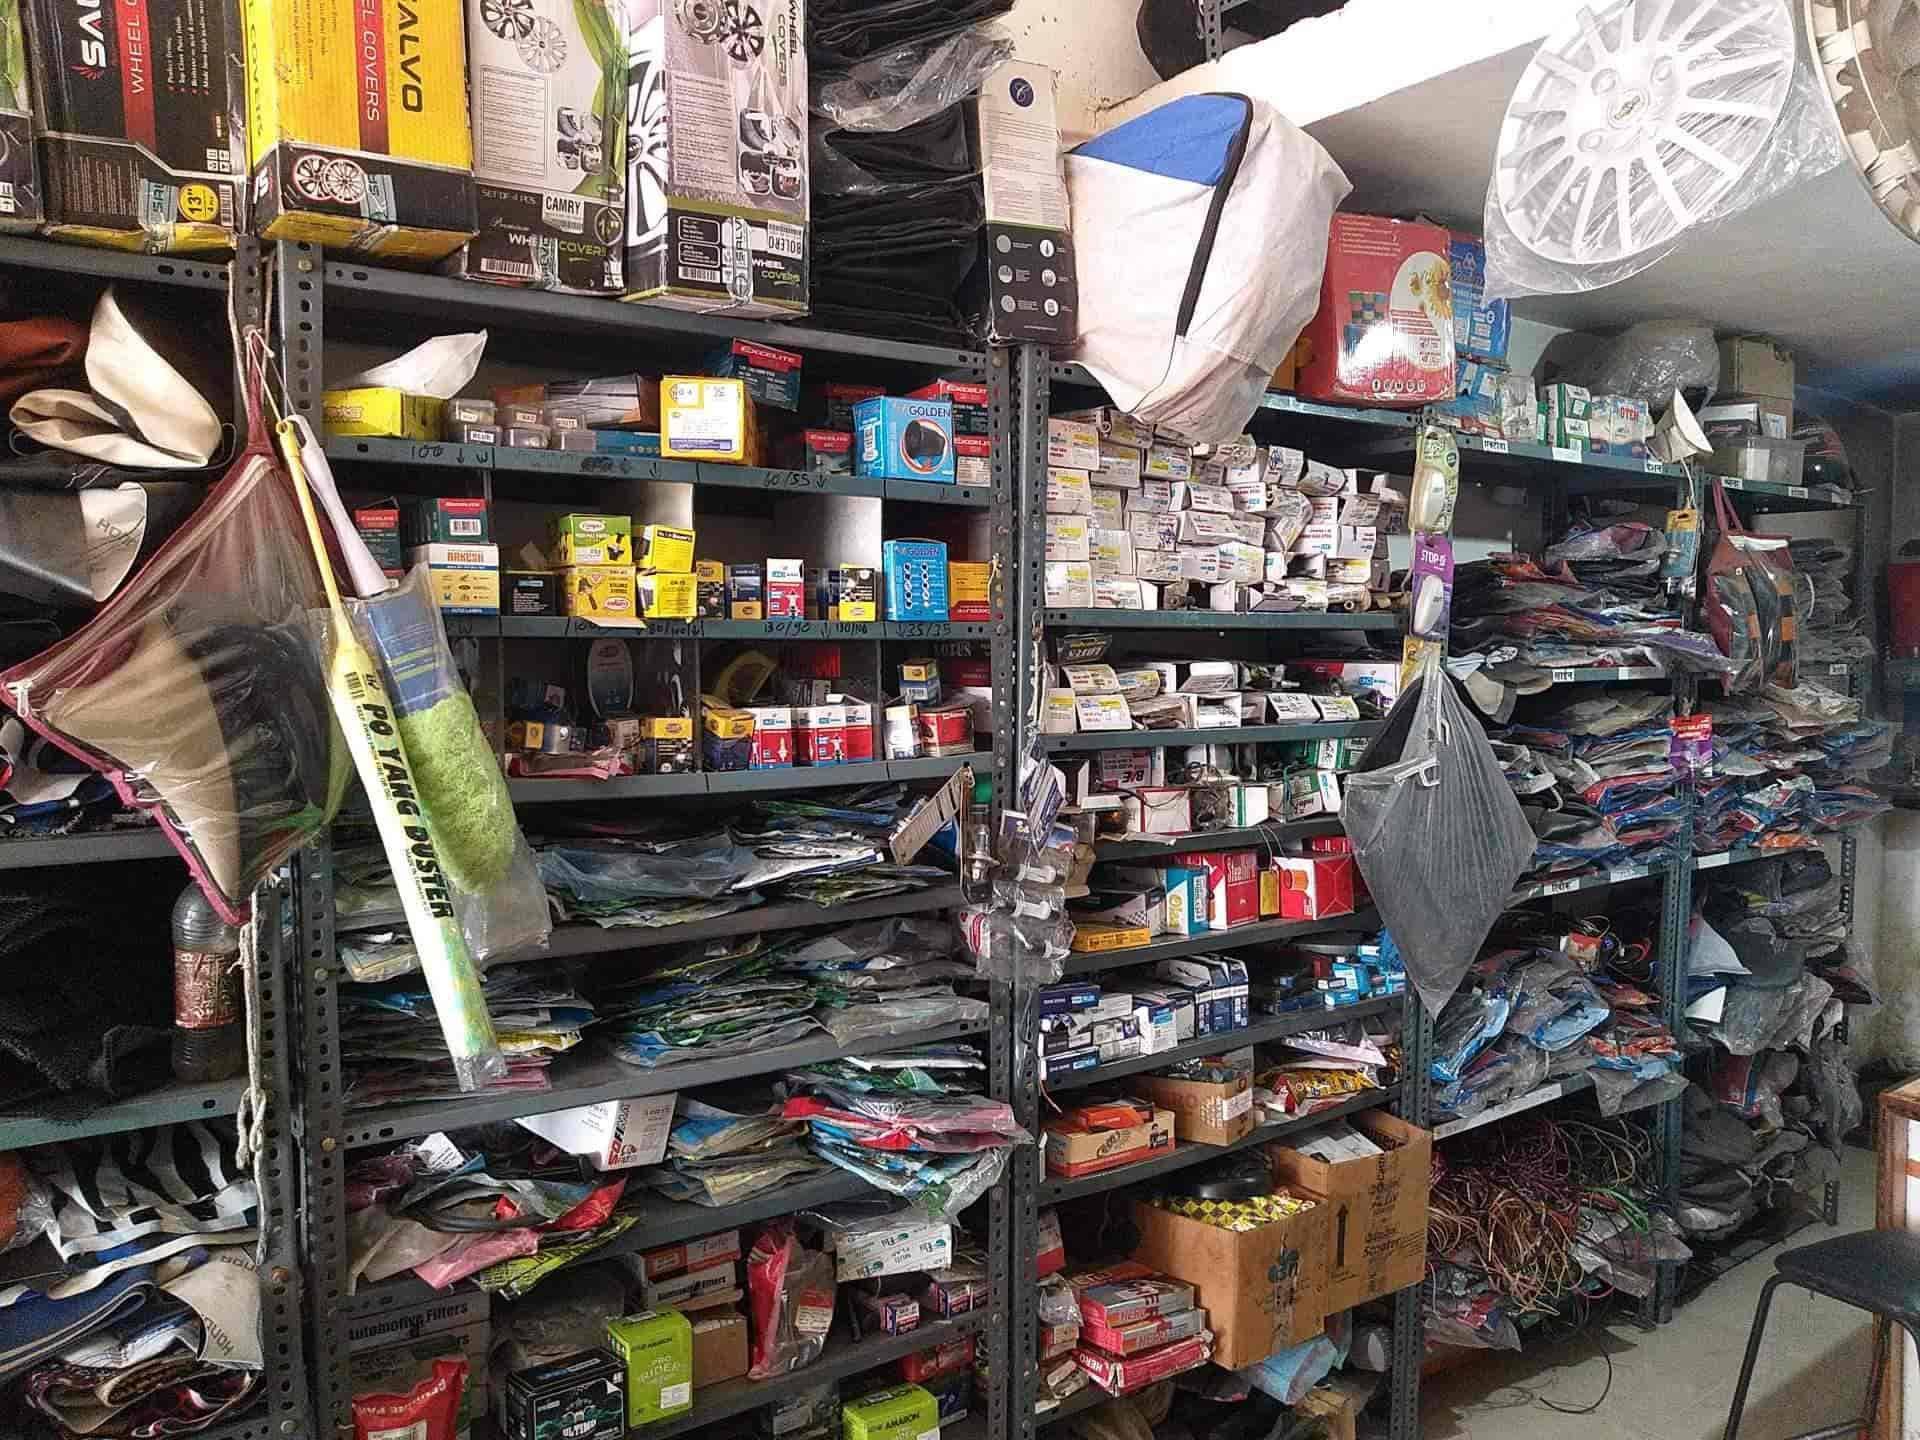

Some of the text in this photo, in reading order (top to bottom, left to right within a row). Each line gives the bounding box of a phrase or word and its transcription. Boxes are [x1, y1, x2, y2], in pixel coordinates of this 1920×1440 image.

[130, 13, 148, 94] WHEEL
[399, 0, 423, 114] ALVO
[778, 14, 787, 87] COVERS
[789, 0, 798, 59] WHEEL
[360, 31, 380, 122] COVERS
[545, 195, 582, 216] CAMRY
[767, 234, 802, 256] BOLERO
[909, 404, 951, 418] GOLDEN
[362, 703, 454, 919] PO YANG DUSTER
[426, 1302, 468, 1322] Filters
